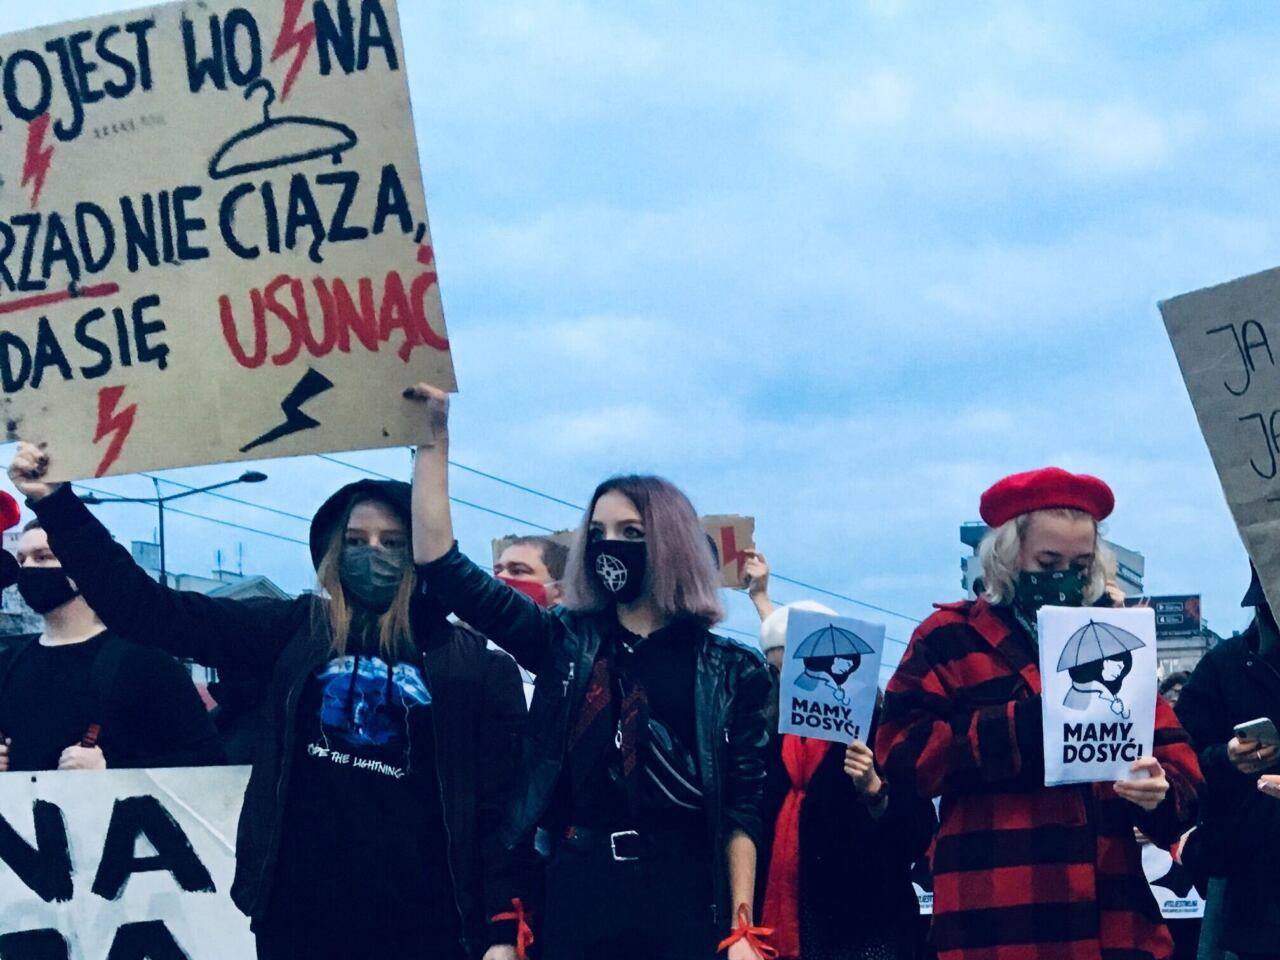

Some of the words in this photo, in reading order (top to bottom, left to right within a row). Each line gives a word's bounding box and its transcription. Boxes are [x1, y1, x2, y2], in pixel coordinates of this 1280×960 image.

[1206, 319, 1275, 396] JA
[792, 697, 851, 720] MAMY
[791, 712, 860, 739] DOSYĆ!
[1063, 723, 1133, 742] MAMY
[1063, 738, 1143, 763] DOSYĆ!
[331, 752, 350, 764] THE
[353, 757, 405, 779] LIGHTNING
